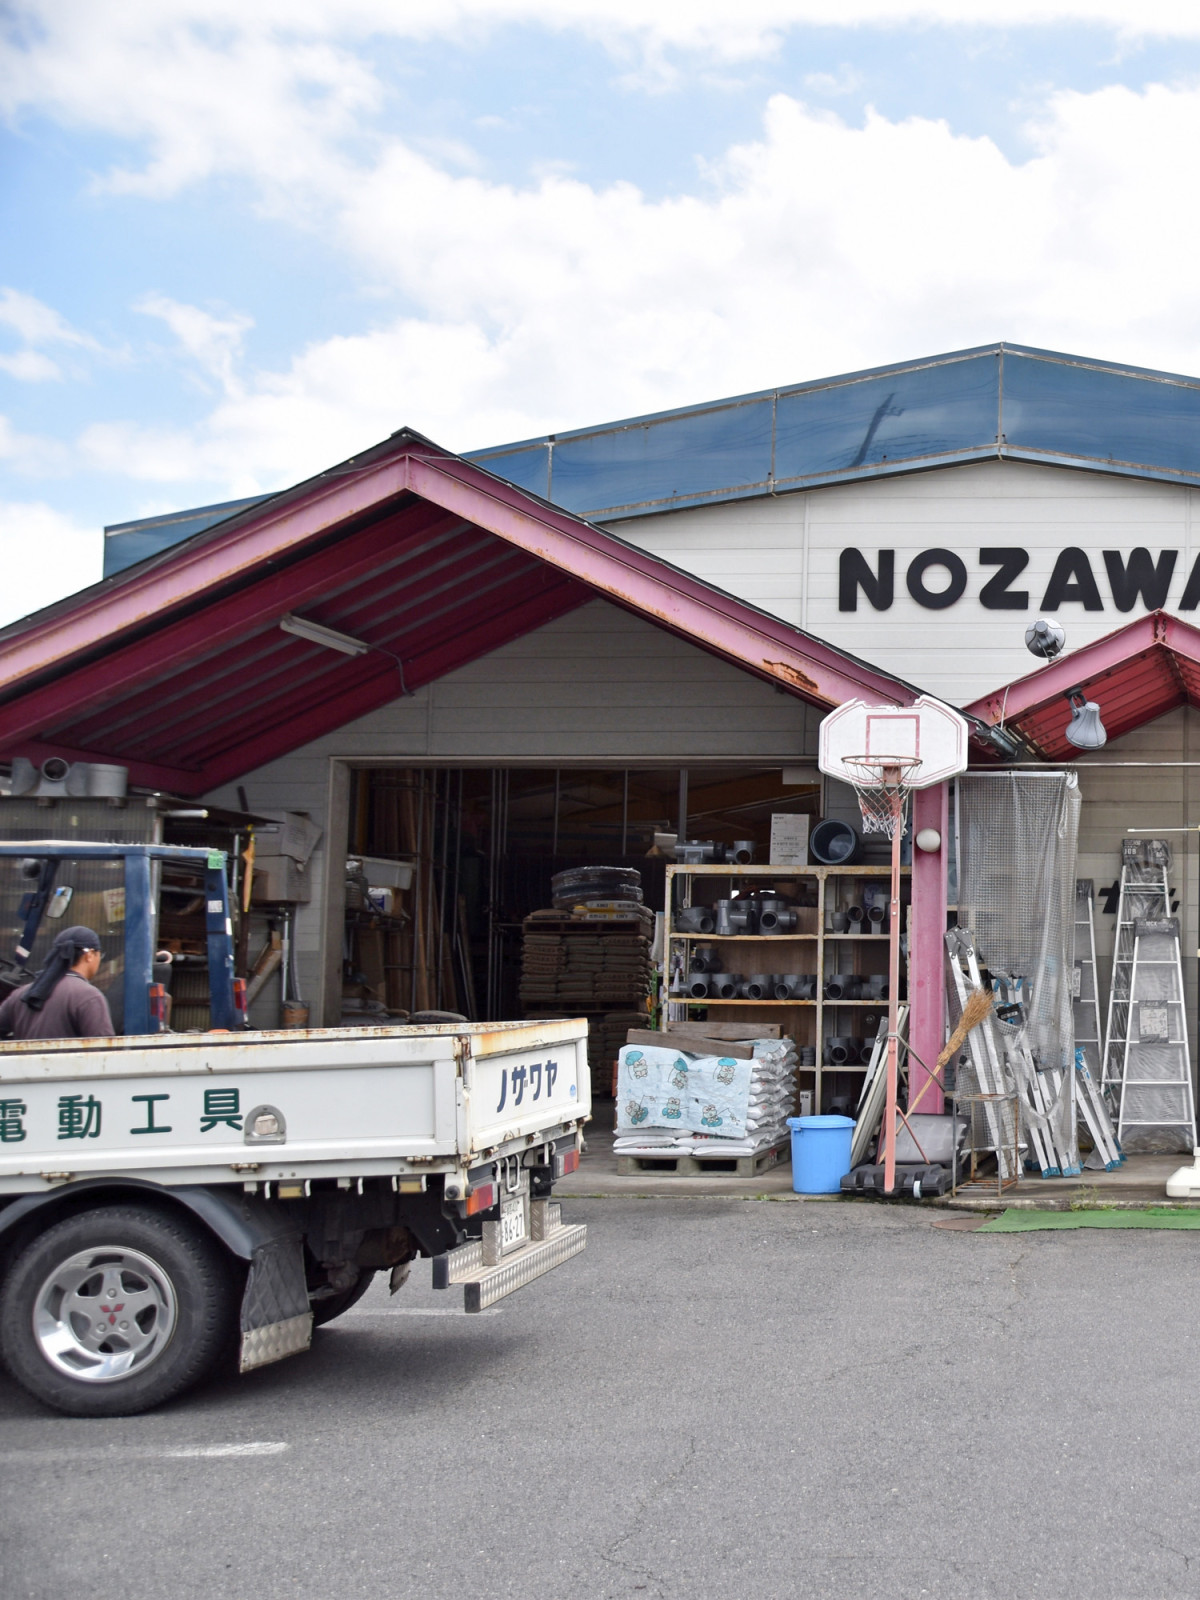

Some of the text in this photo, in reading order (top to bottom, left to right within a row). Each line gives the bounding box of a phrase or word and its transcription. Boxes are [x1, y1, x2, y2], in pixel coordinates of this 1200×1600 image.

[497, 1060, 558, 1113] ノザワヤ
[0, 1088, 243, 1142] 電動工具
